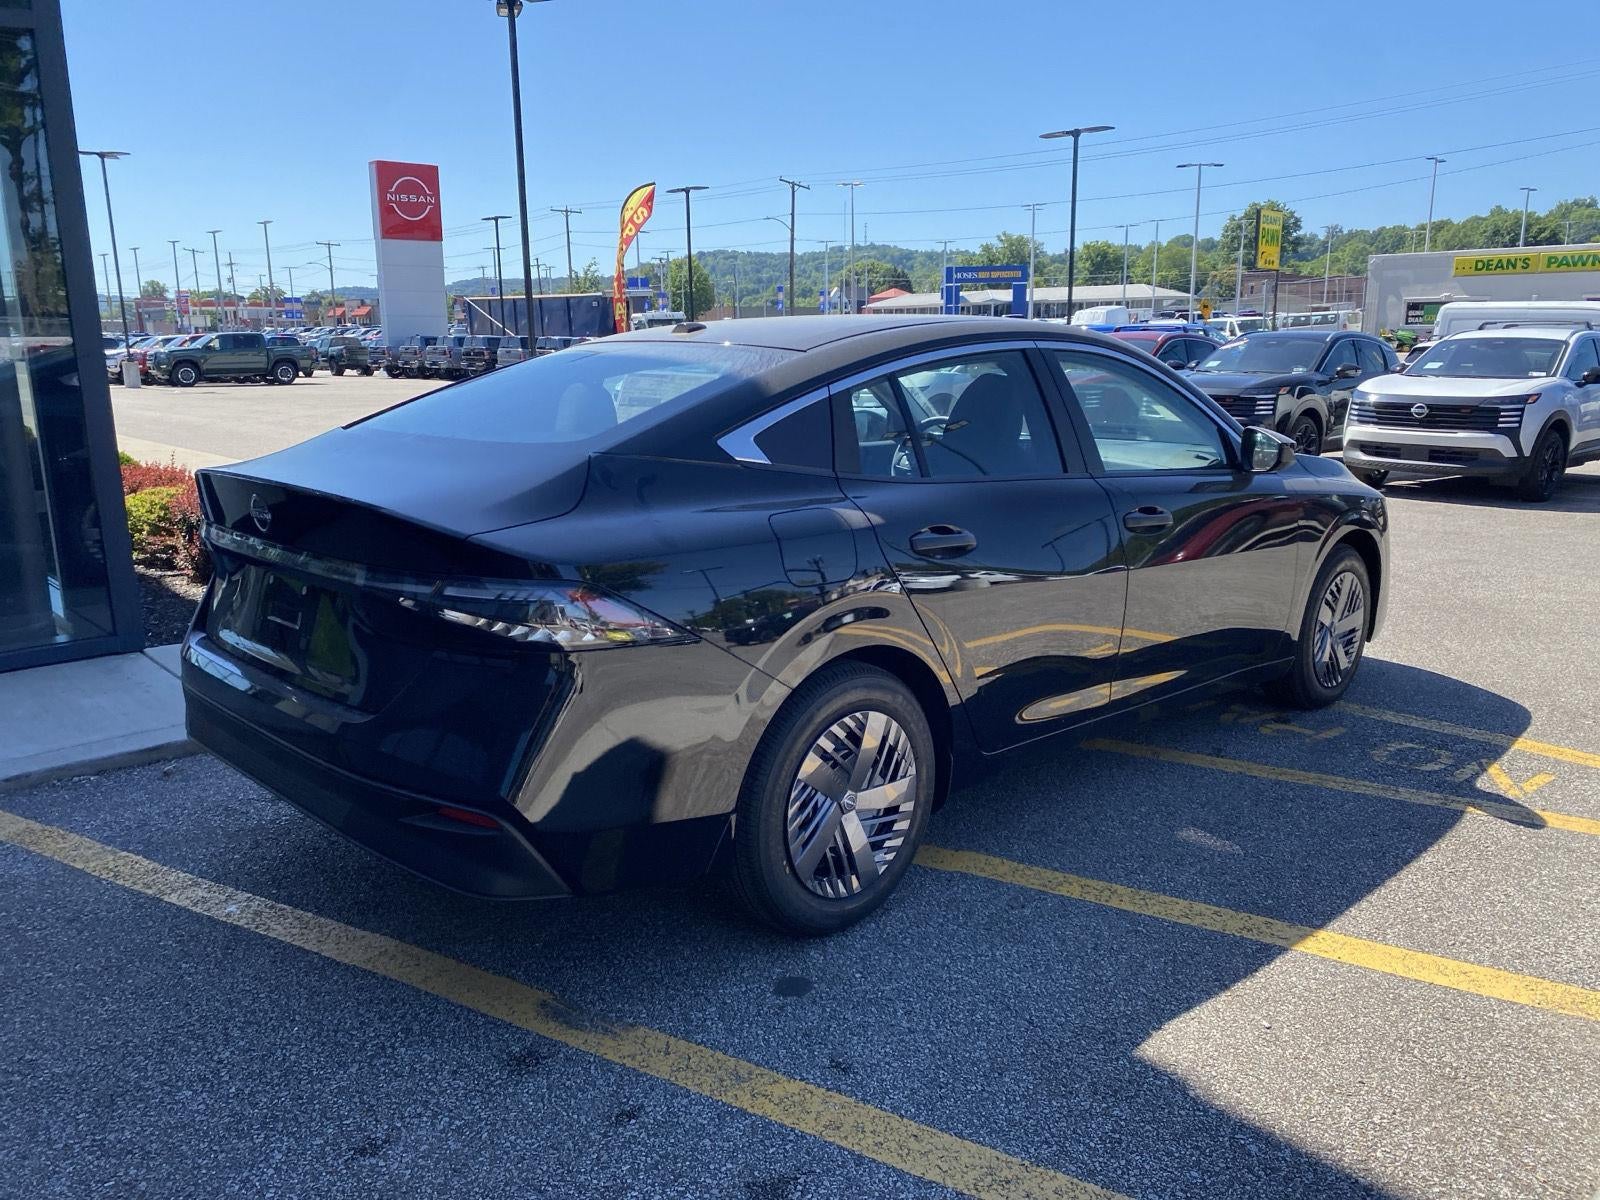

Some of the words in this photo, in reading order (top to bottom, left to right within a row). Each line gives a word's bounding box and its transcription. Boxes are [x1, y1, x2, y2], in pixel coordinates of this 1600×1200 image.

[386, 193, 434, 203] NISSAN
[1261, 227, 1280, 246] PAWN
[1474, 257, 1531, 271] DEAN'S
